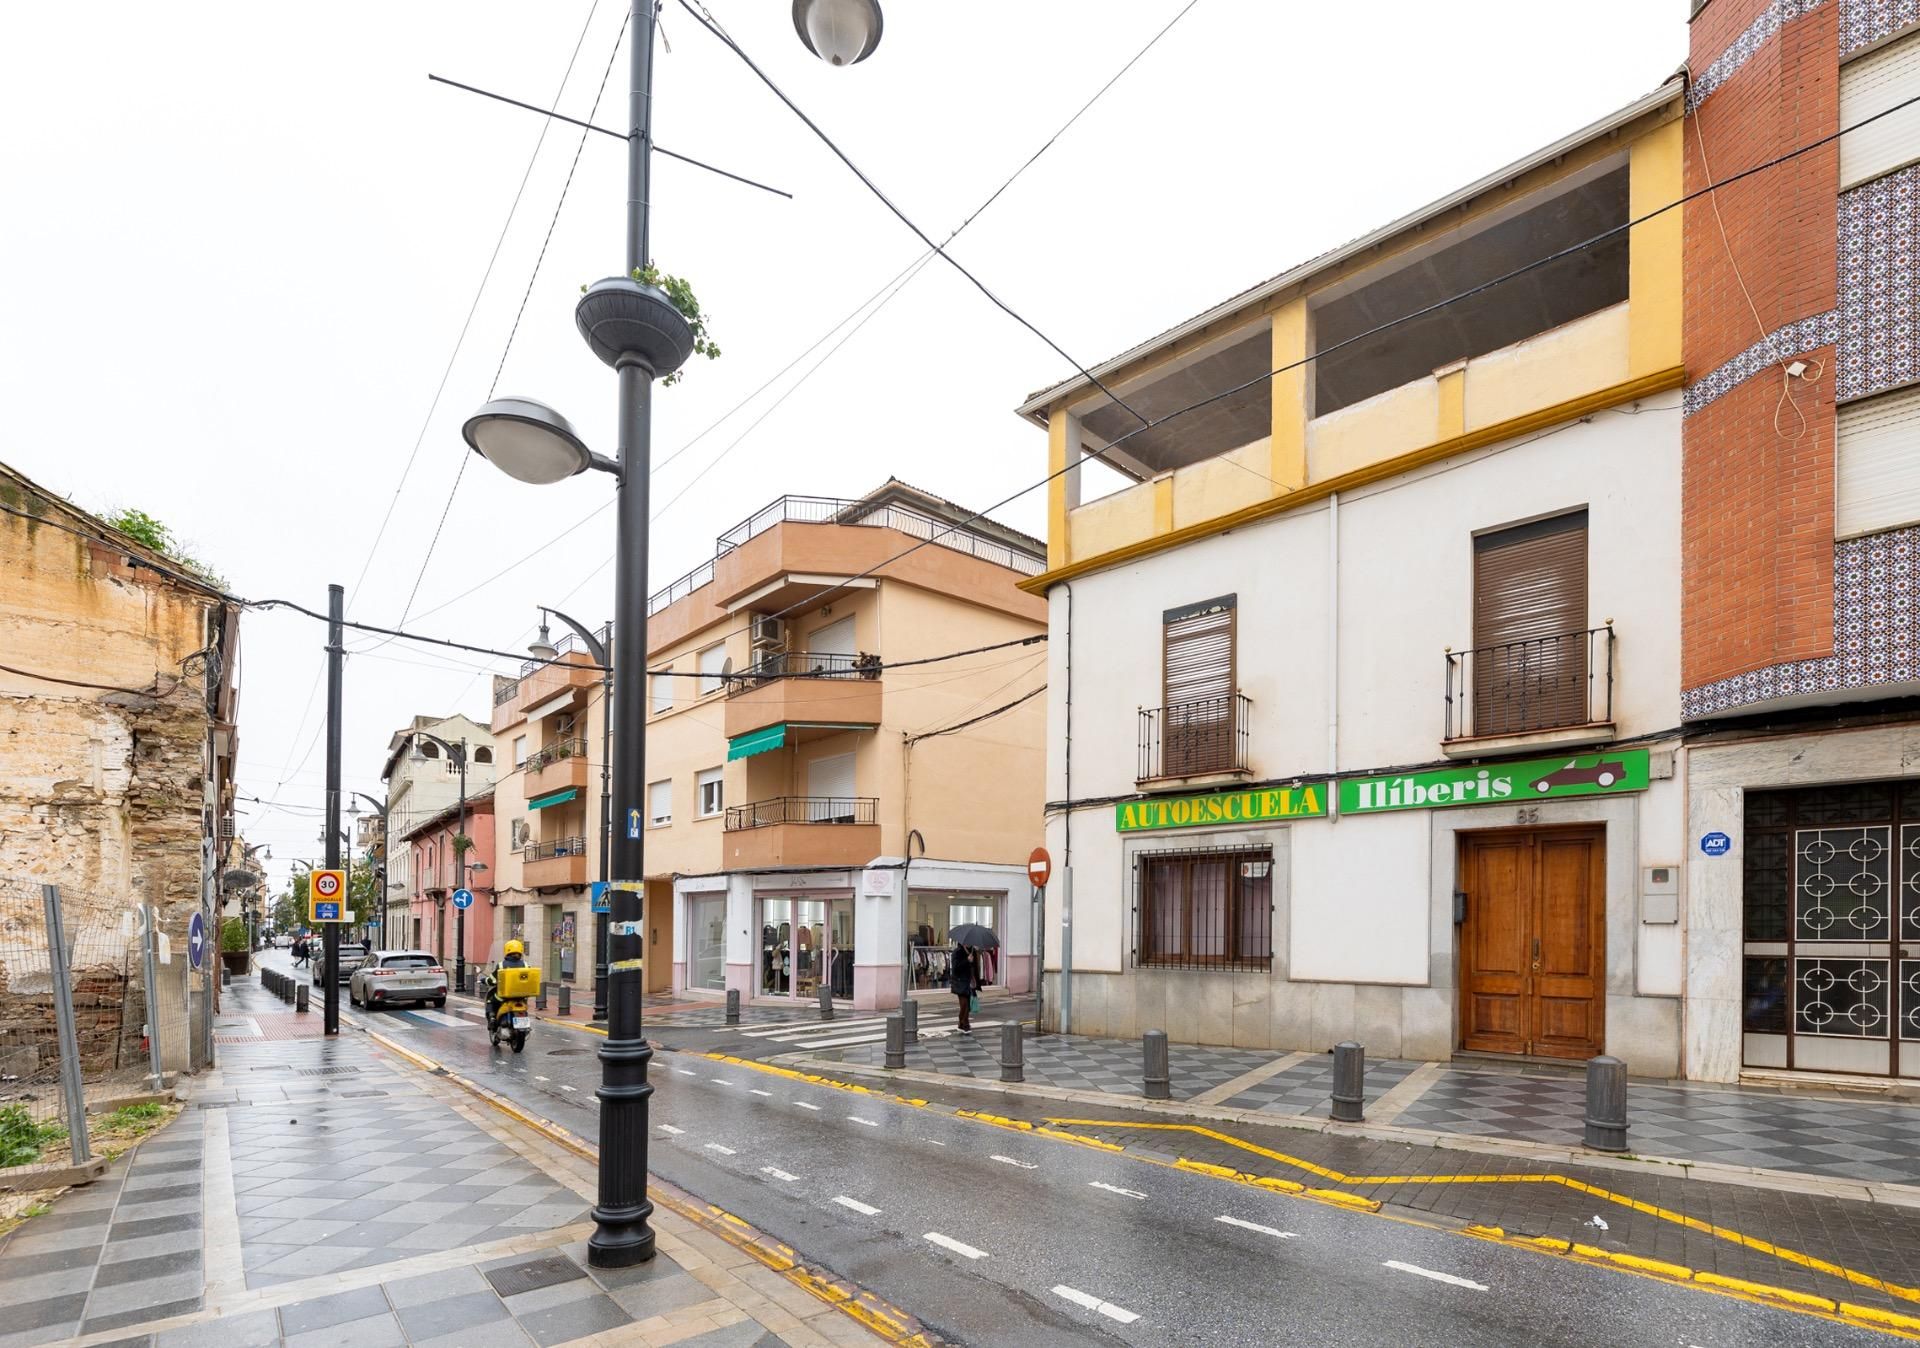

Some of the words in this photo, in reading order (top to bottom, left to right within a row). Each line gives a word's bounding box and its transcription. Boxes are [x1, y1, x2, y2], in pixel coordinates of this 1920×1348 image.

[1356, 770, 1512, 809] Ilíberis
[1121, 787, 1320, 828] AUTOESCUELA
[1705, 839, 1726, 847] ADT
[321, 880, 335, 889] 30
